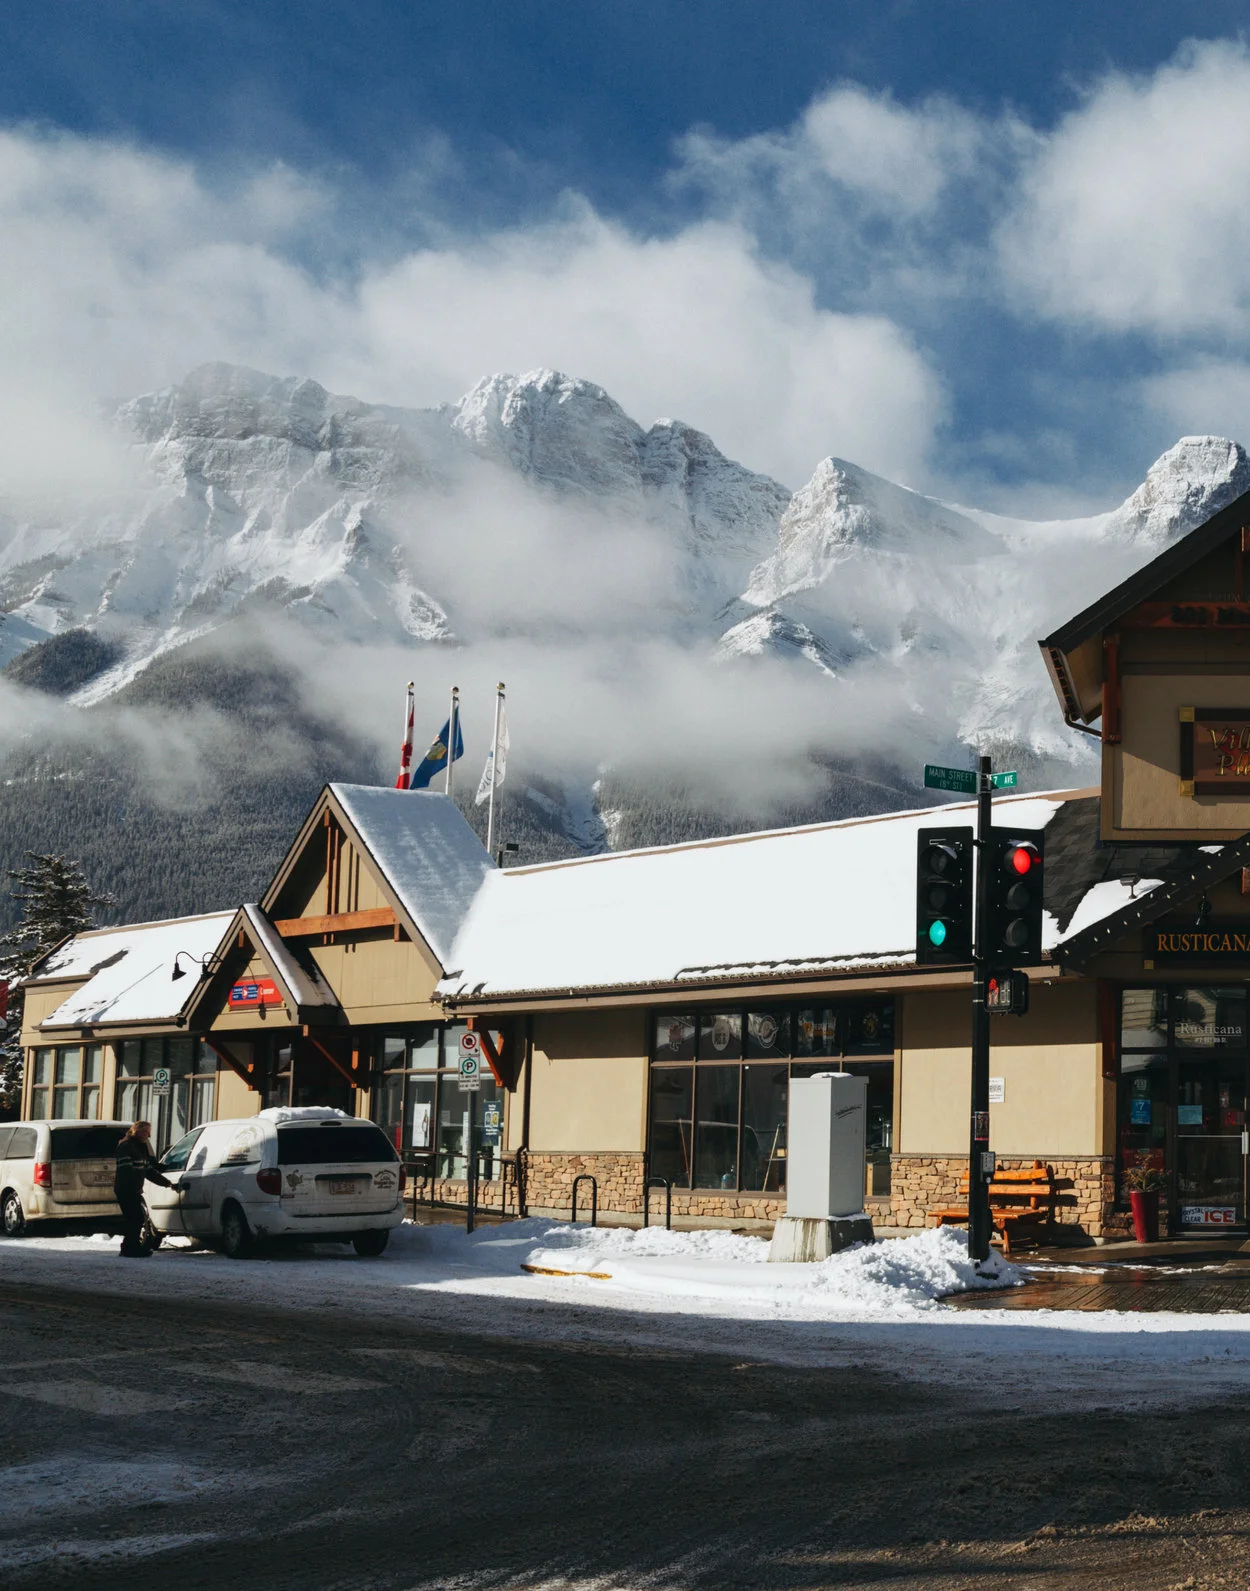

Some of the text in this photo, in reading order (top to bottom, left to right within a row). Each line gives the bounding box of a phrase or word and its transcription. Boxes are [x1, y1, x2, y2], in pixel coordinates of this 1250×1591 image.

[928, 767, 973, 782] MAIN STREET
[1003, 774, 1014, 784] AVE
[1180, 1022, 1242, 1035] Rusticana
[1204, 1209, 1234, 1223] ICE
